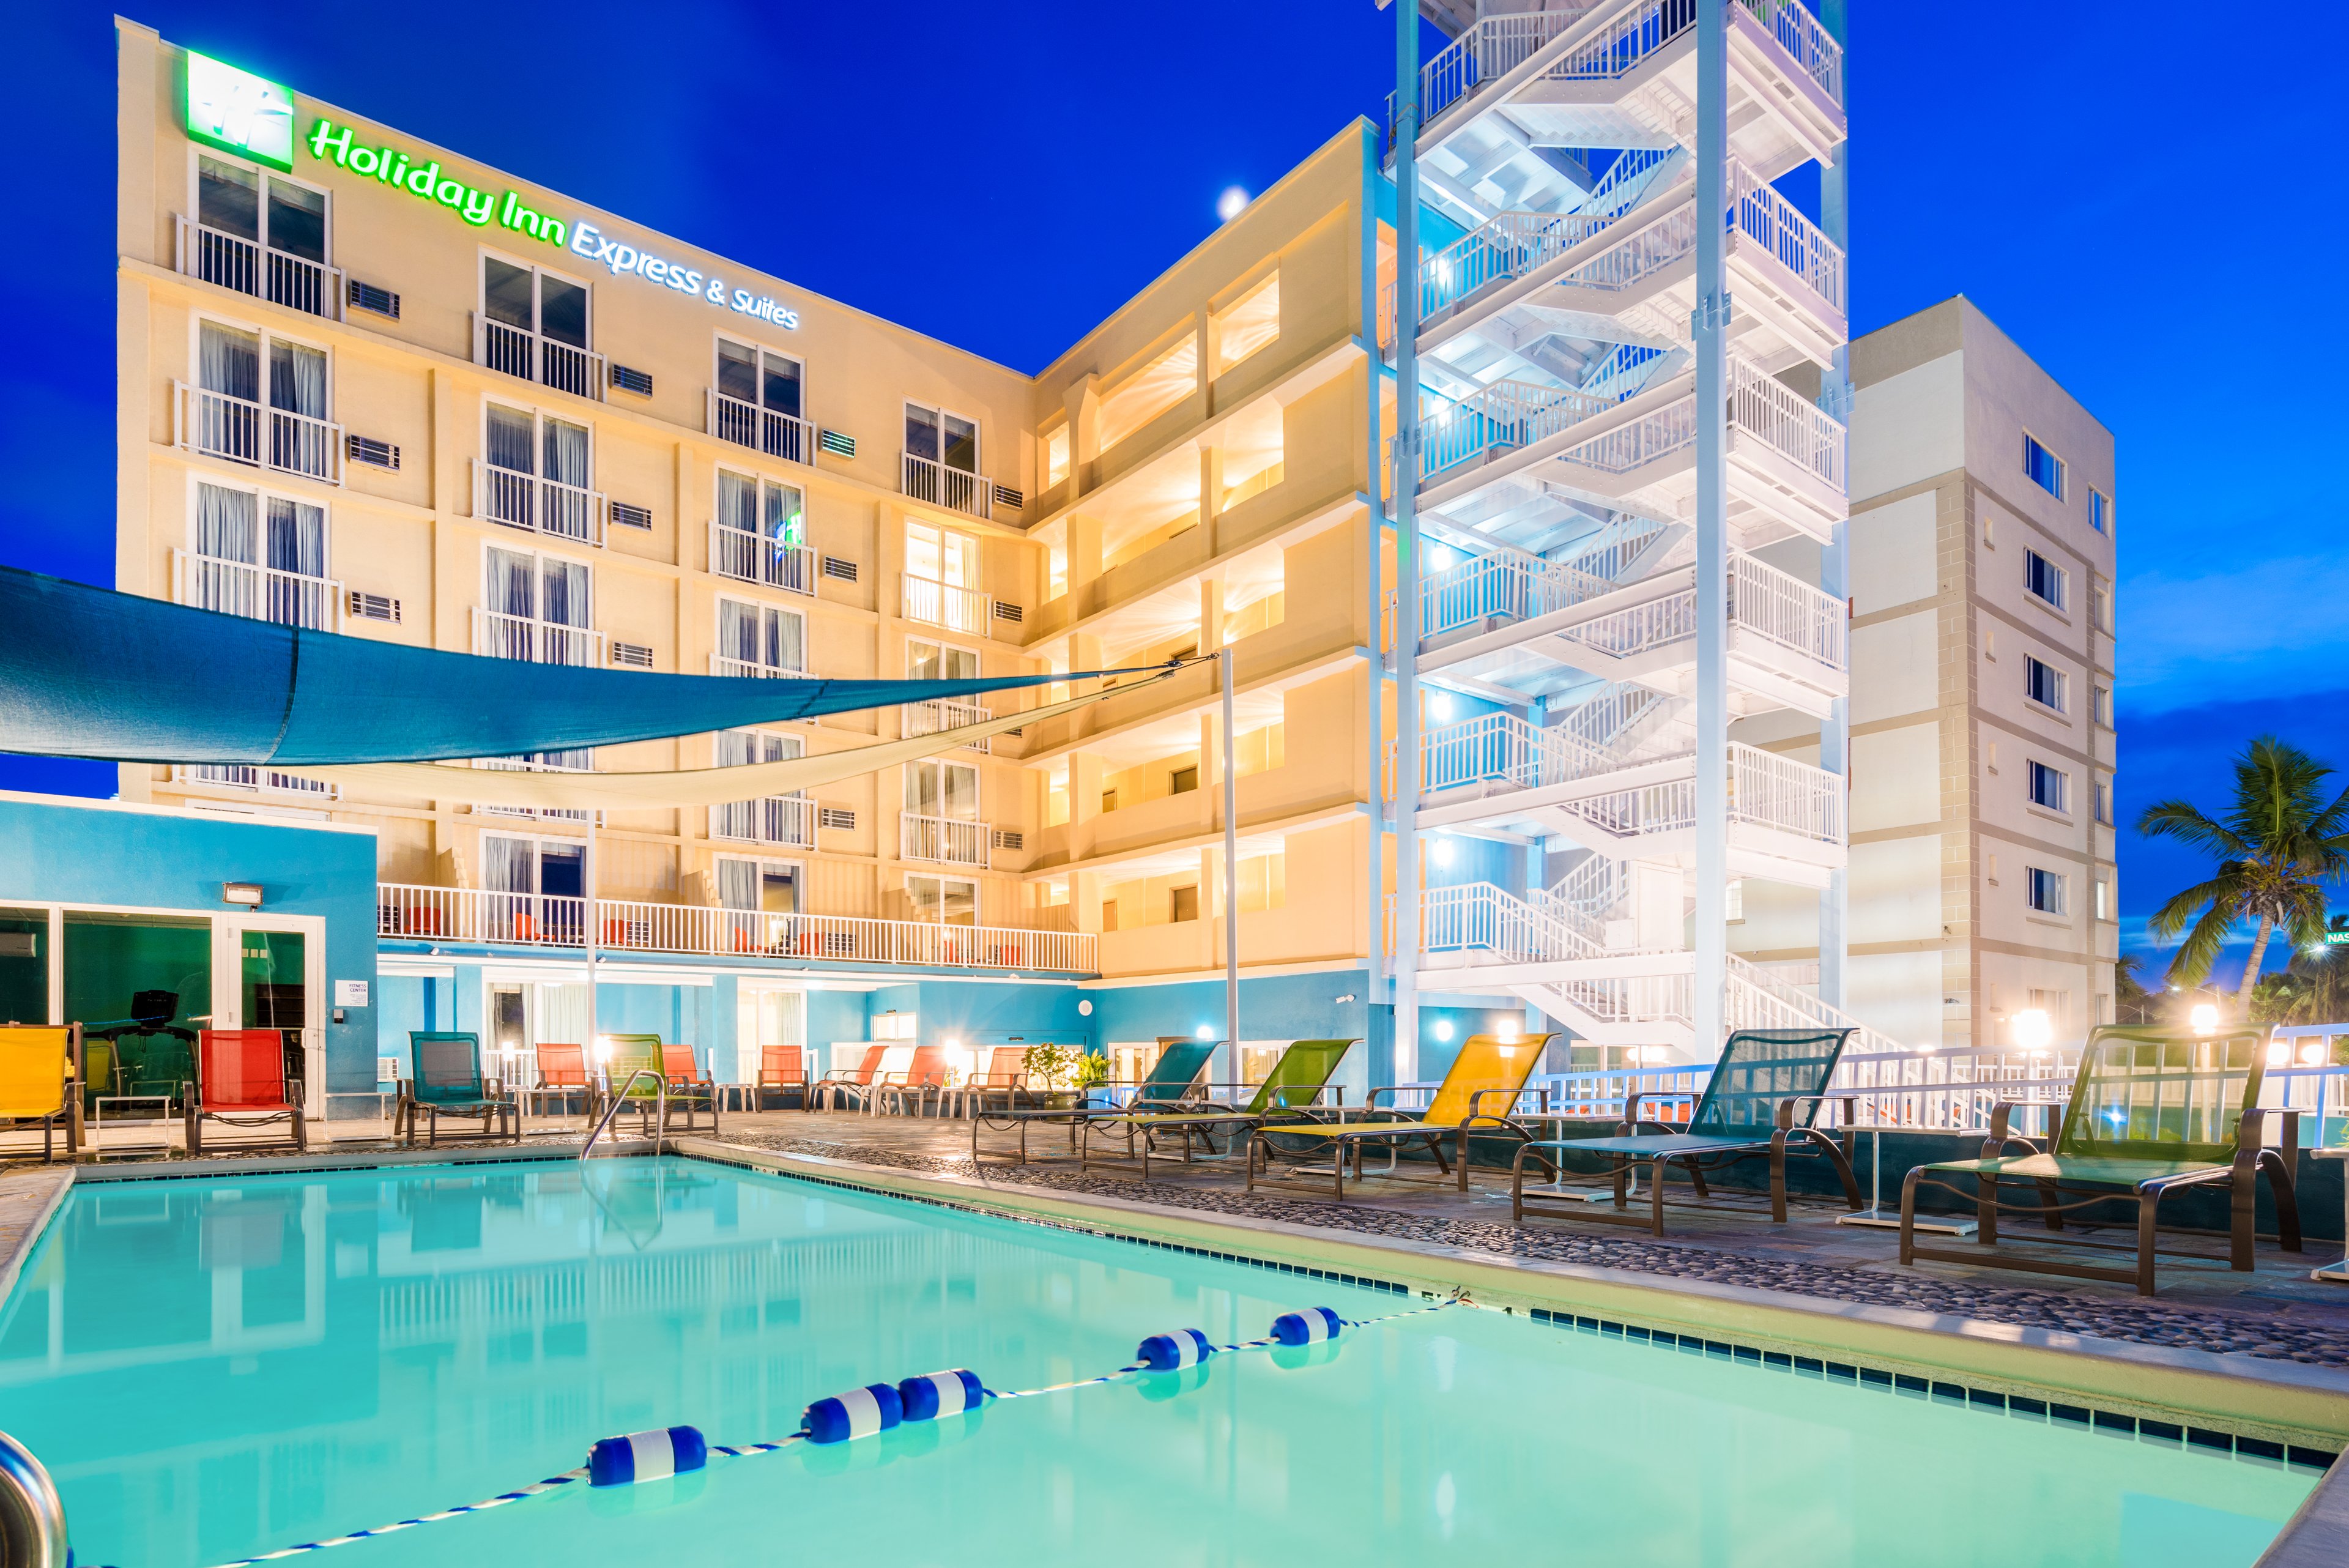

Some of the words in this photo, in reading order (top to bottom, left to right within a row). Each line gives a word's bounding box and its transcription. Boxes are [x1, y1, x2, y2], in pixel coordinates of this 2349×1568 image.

[309, 119, 495, 226] Holiday
[499, 191, 566, 248] Inn
[571, 221, 703, 295] Express
[705, 280, 725, 306] &
[730, 289, 798, 330] Suites
